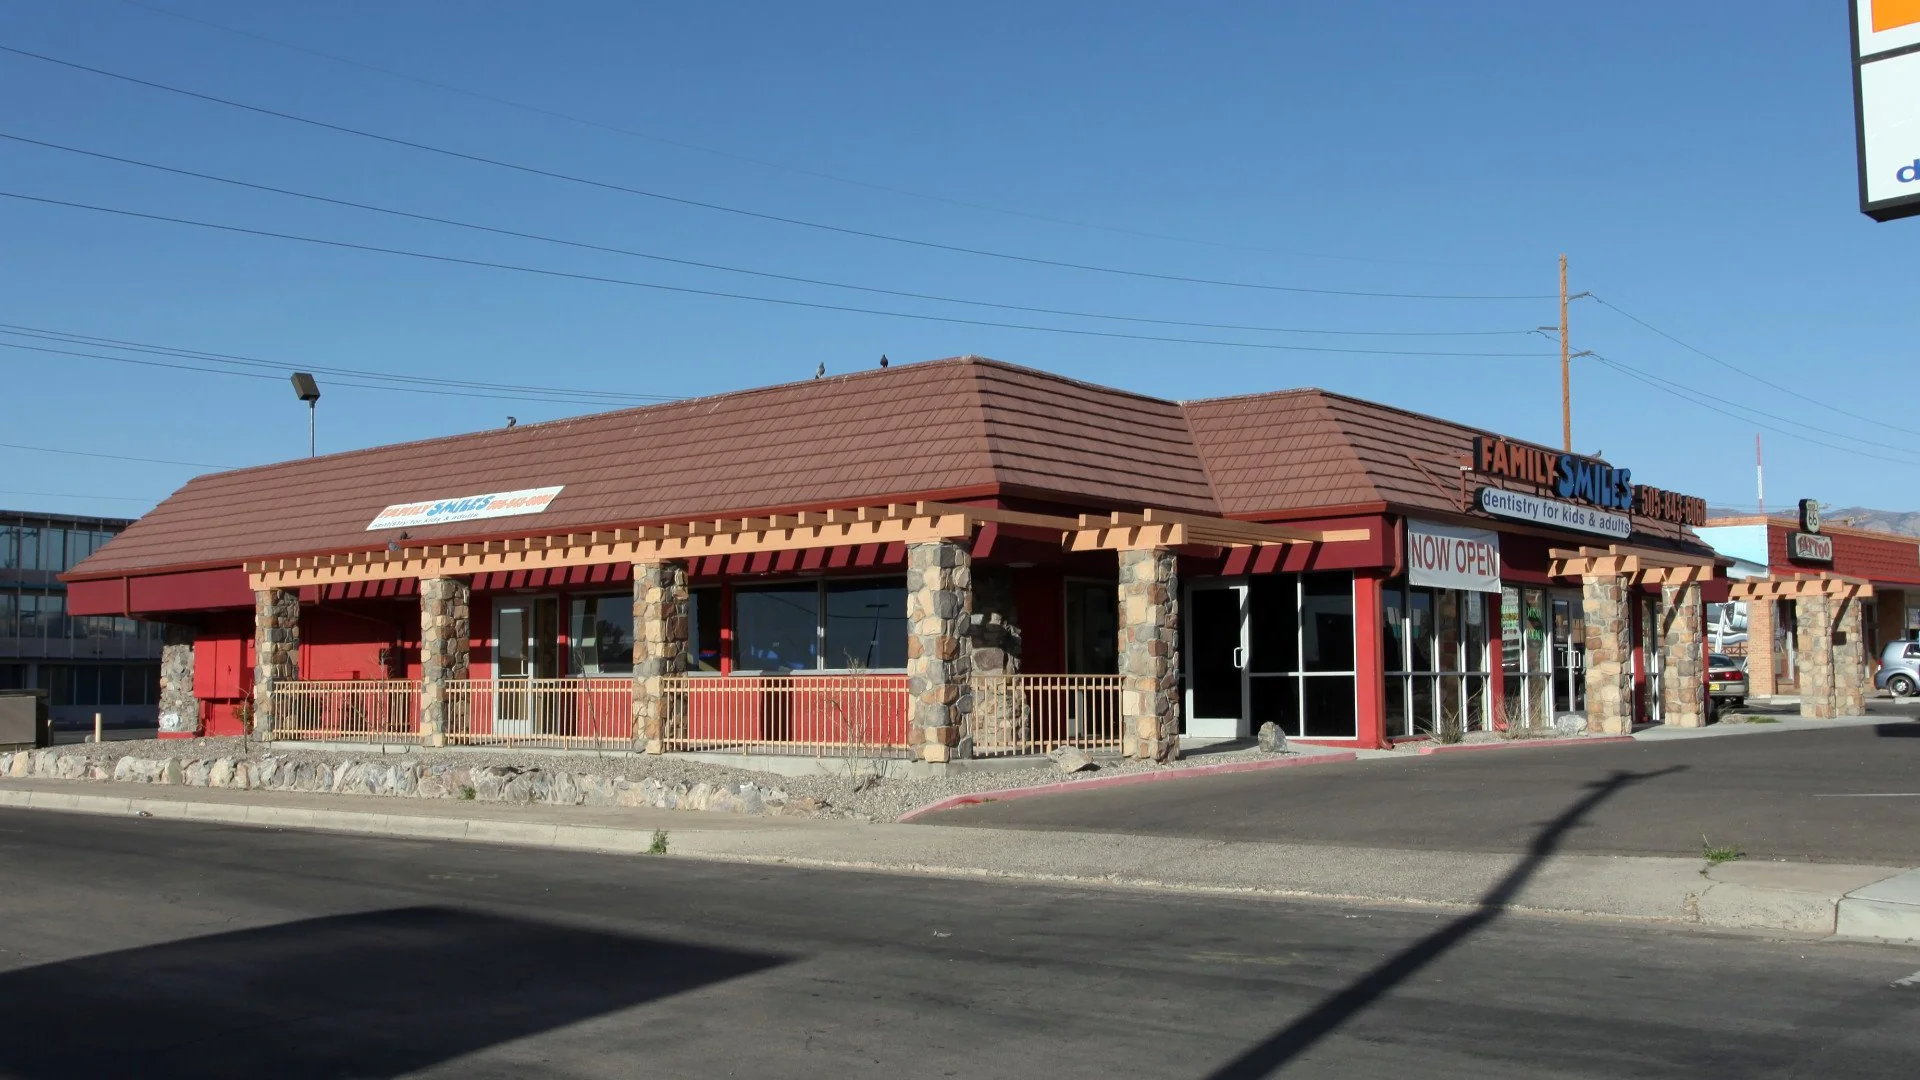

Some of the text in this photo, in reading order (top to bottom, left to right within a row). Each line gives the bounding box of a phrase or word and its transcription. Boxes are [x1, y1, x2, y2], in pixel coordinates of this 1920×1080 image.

[1480, 436, 1706, 527] FAMILY SMILES 505-843-6060
[427, 495, 496, 517] SMILES
[1483, 490, 1631, 534] dentistry for kids & adults
[1808, 511, 1818, 526] 66
[1411, 533, 1497, 577] NOW OPEN
[1798, 536, 1830, 559] TATTOO
